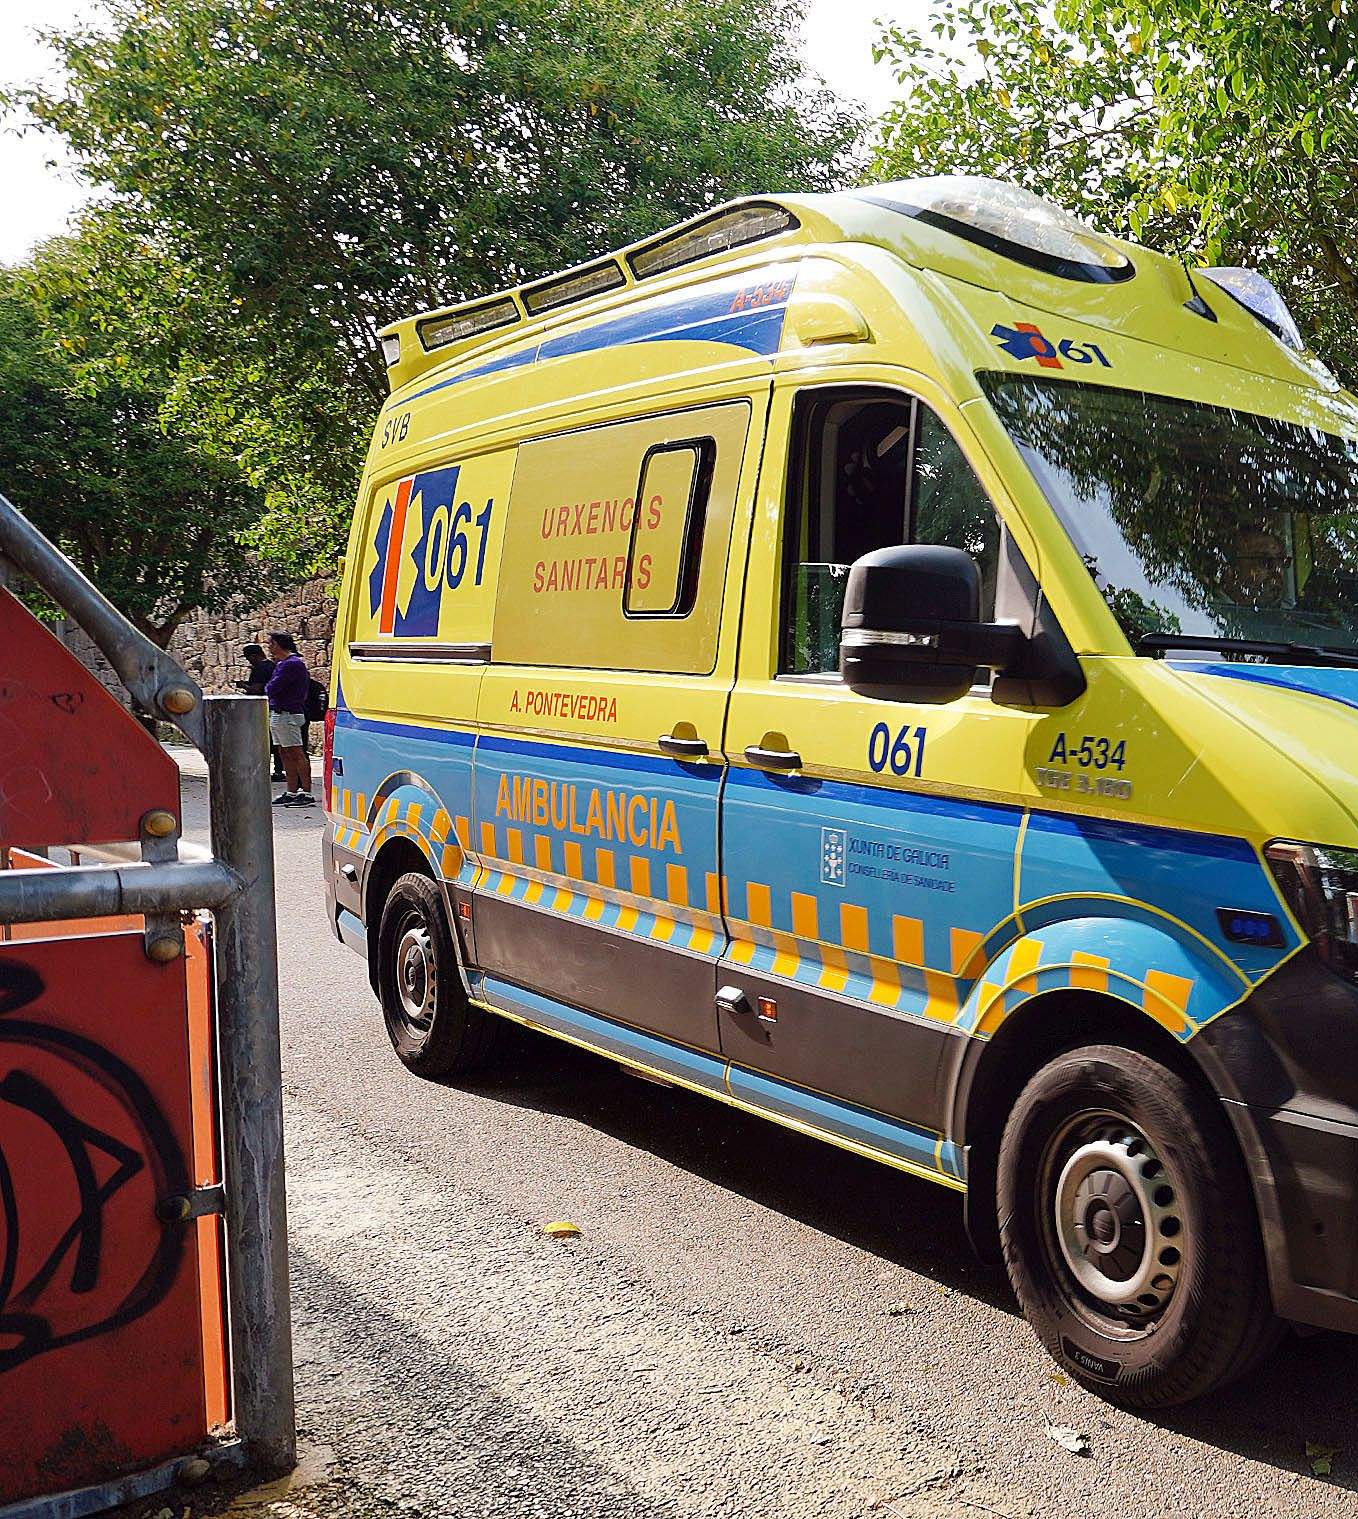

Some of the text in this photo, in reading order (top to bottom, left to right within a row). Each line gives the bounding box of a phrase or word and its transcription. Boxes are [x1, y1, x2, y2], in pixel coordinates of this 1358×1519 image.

[381, 412, 411, 449] SVB
[424, 498, 494, 593] 061
[510, 689, 618, 723] A. PONTEVEDRA
[869, 722, 927, 778] 061
[1047, 732, 1127, 771] A-534
[495, 772, 684, 855] AMBULANCIA
[848, 837, 950, 870] XUNTA DE GALICIA
